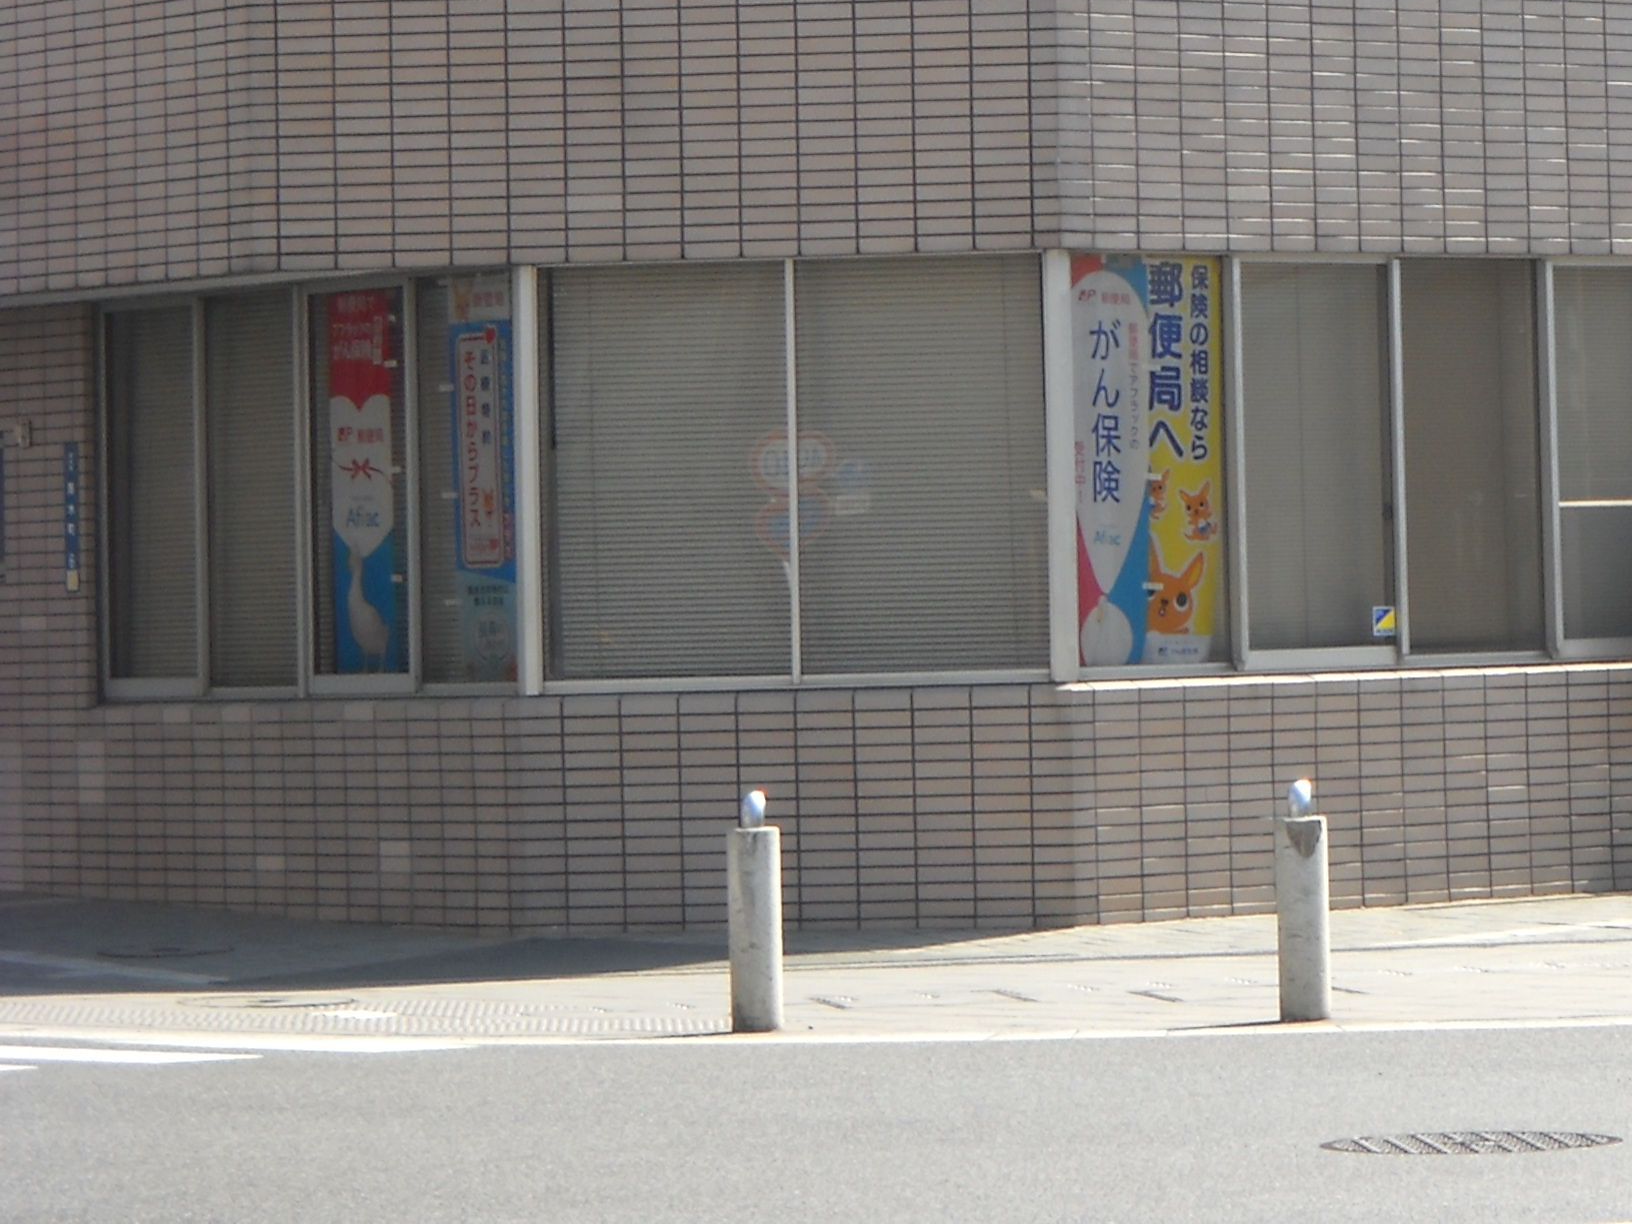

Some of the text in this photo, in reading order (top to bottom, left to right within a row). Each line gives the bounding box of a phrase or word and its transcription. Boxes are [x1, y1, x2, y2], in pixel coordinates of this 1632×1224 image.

[464, 350, 481, 528] その日からプラス
[1089, 319, 1121, 503] がん保険
[1149, 261, 1184, 458] 郵便局へ
[1190, 264, 1208, 461] 保険の相談なら
[346, 506, 380, 528] Aflac
